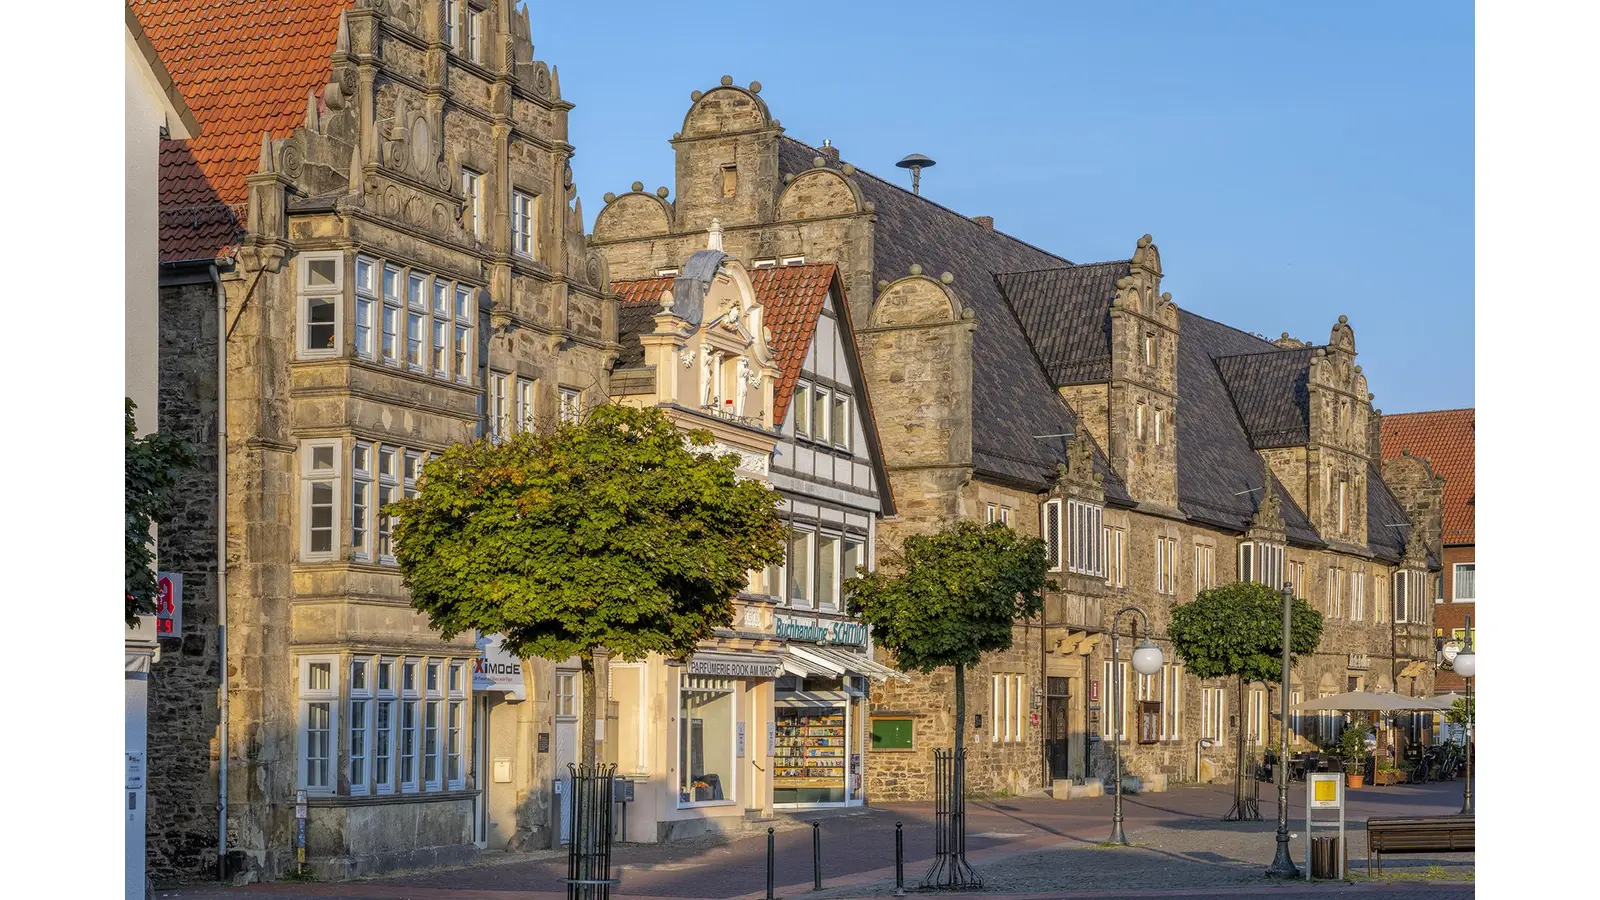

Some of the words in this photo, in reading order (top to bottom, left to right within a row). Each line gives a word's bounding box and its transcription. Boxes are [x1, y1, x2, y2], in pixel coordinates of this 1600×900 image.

[776, 618, 828, 643] Buchhandlung
[691, 661, 730, 675] PARFÜMERIE
[750, 664, 759, 676] AM
